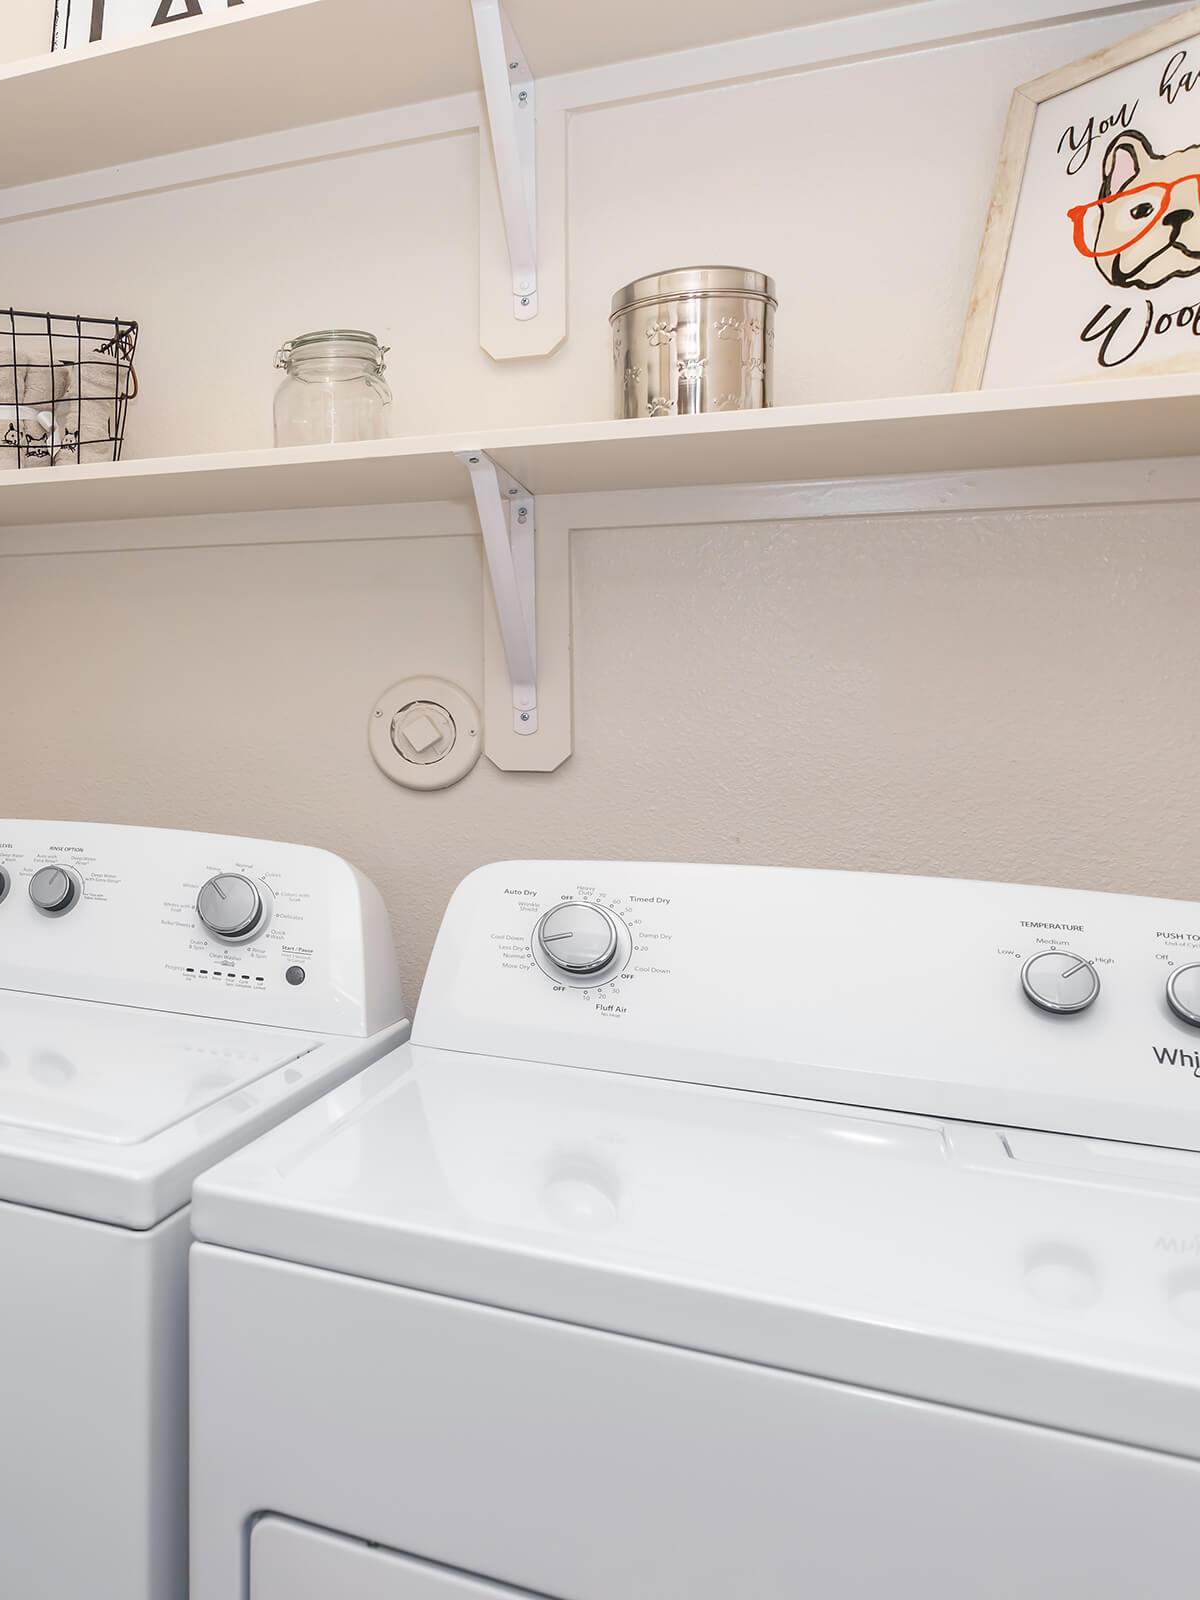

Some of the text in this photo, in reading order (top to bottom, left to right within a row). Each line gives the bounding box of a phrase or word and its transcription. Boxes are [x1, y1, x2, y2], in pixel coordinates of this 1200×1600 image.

[1057, 51, 1200, 175] You ha
[1080, 299, 1200, 367] Woo
[656, 897, 671, 905] Dry
[1019, 920, 1085, 932] TEMPERATURE
[1156, 931, 1184, 940] PUSH
[1035, 938, 1070, 946] Medium
[998, 948, 1014, 956] Low
[1095, 957, 1114, 965] High
